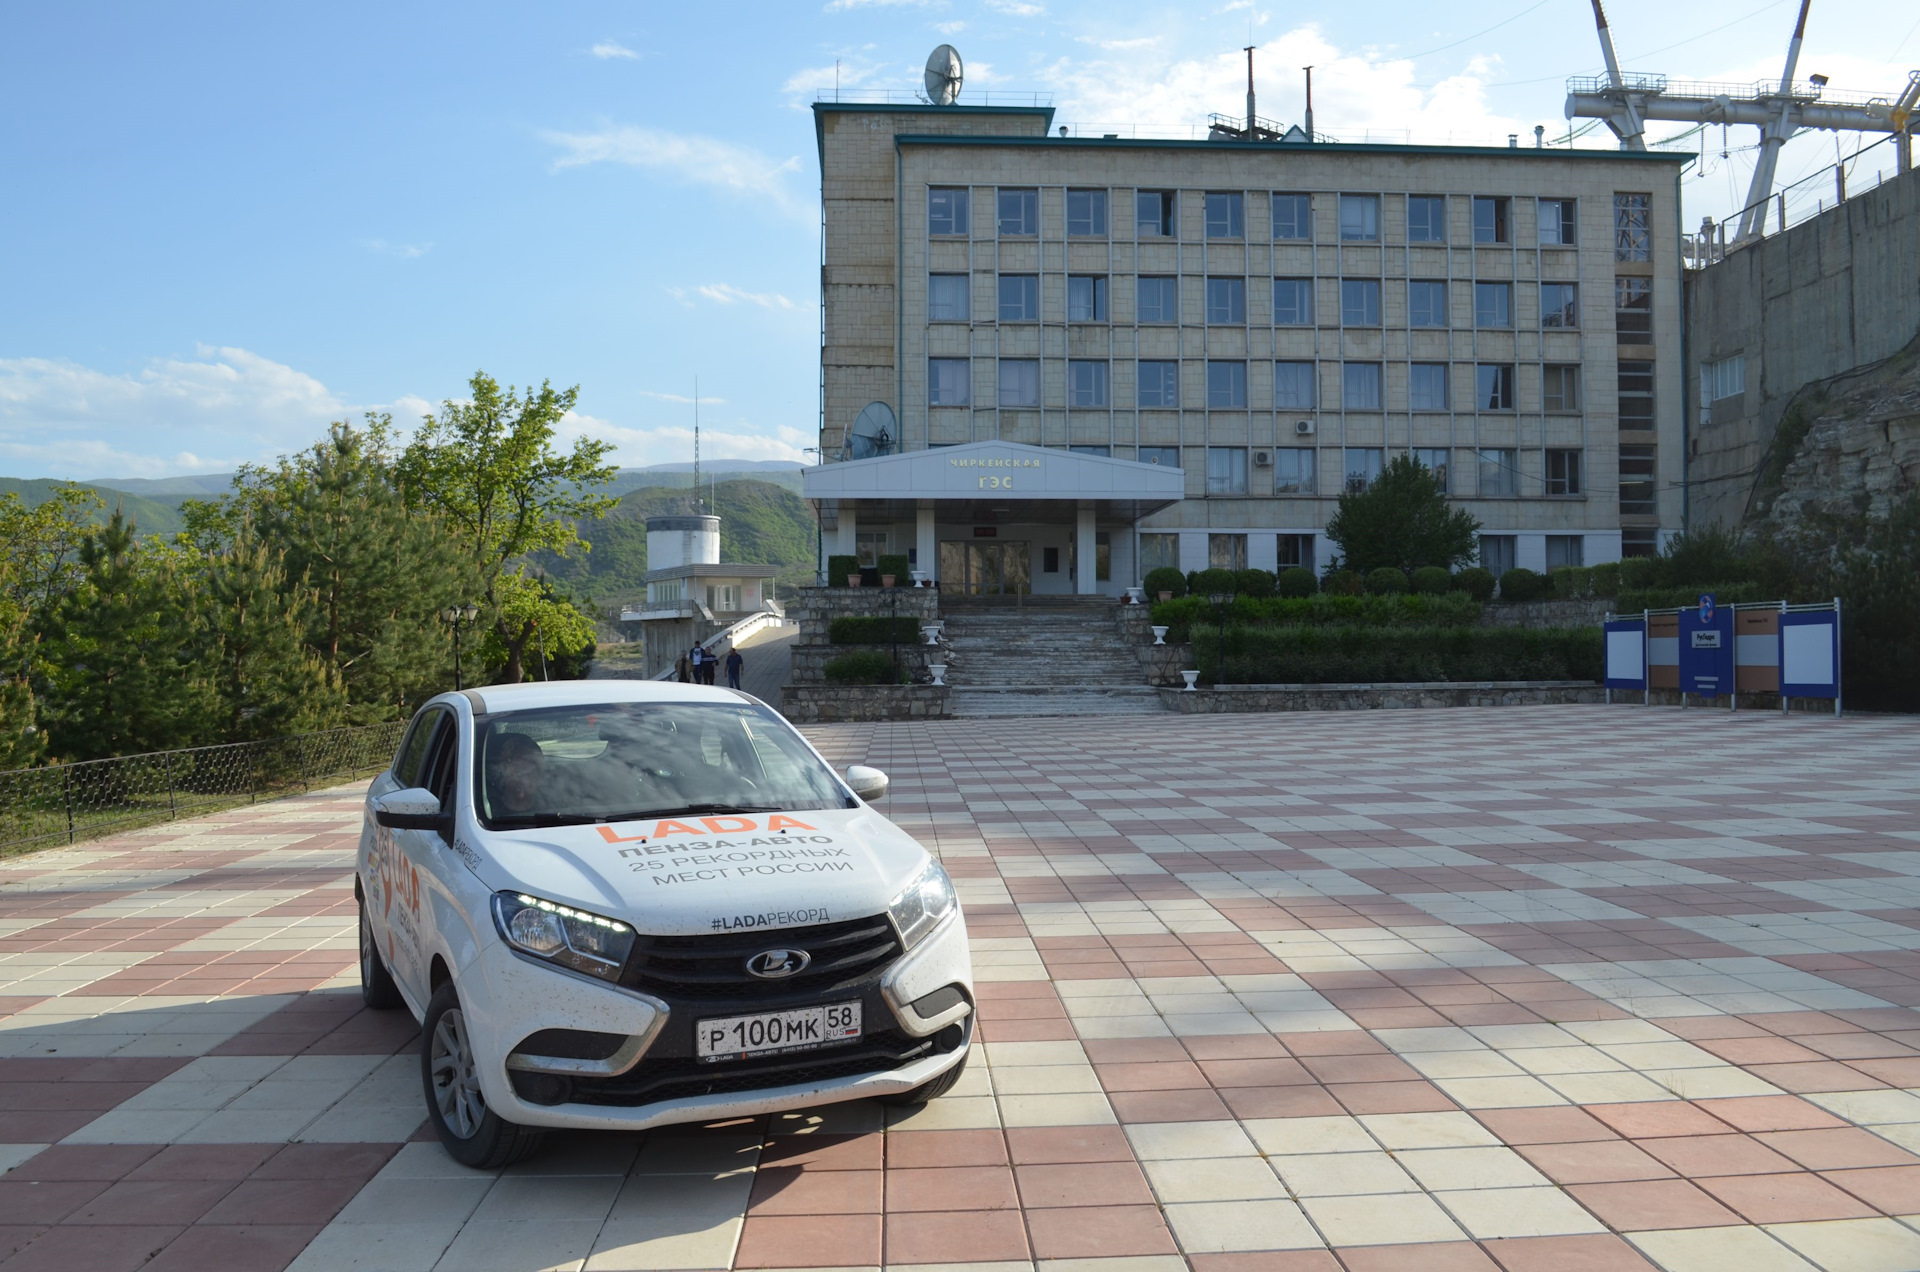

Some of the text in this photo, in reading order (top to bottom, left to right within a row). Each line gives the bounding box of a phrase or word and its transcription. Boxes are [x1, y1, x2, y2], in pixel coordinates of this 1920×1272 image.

[950, 457, 1040, 467] ЧИРКЕЙСКАЯ
[979, 476, 1012, 489] ГЭС
[595, 814, 819, 844] LADA
[618, 834, 833, 858] ПЕНЗА-АВТО
[629, 847, 852, 873] 25 РЕКОРДНЫХ
[392, 841, 421, 925] LADA
[652, 860, 854, 886] МЕСТ РОССИИ
[711, 907, 830, 931] #LADAРЕКОРД
[827, 1007, 852, 1028] 58
[825, 1027, 845, 1039] RUS
